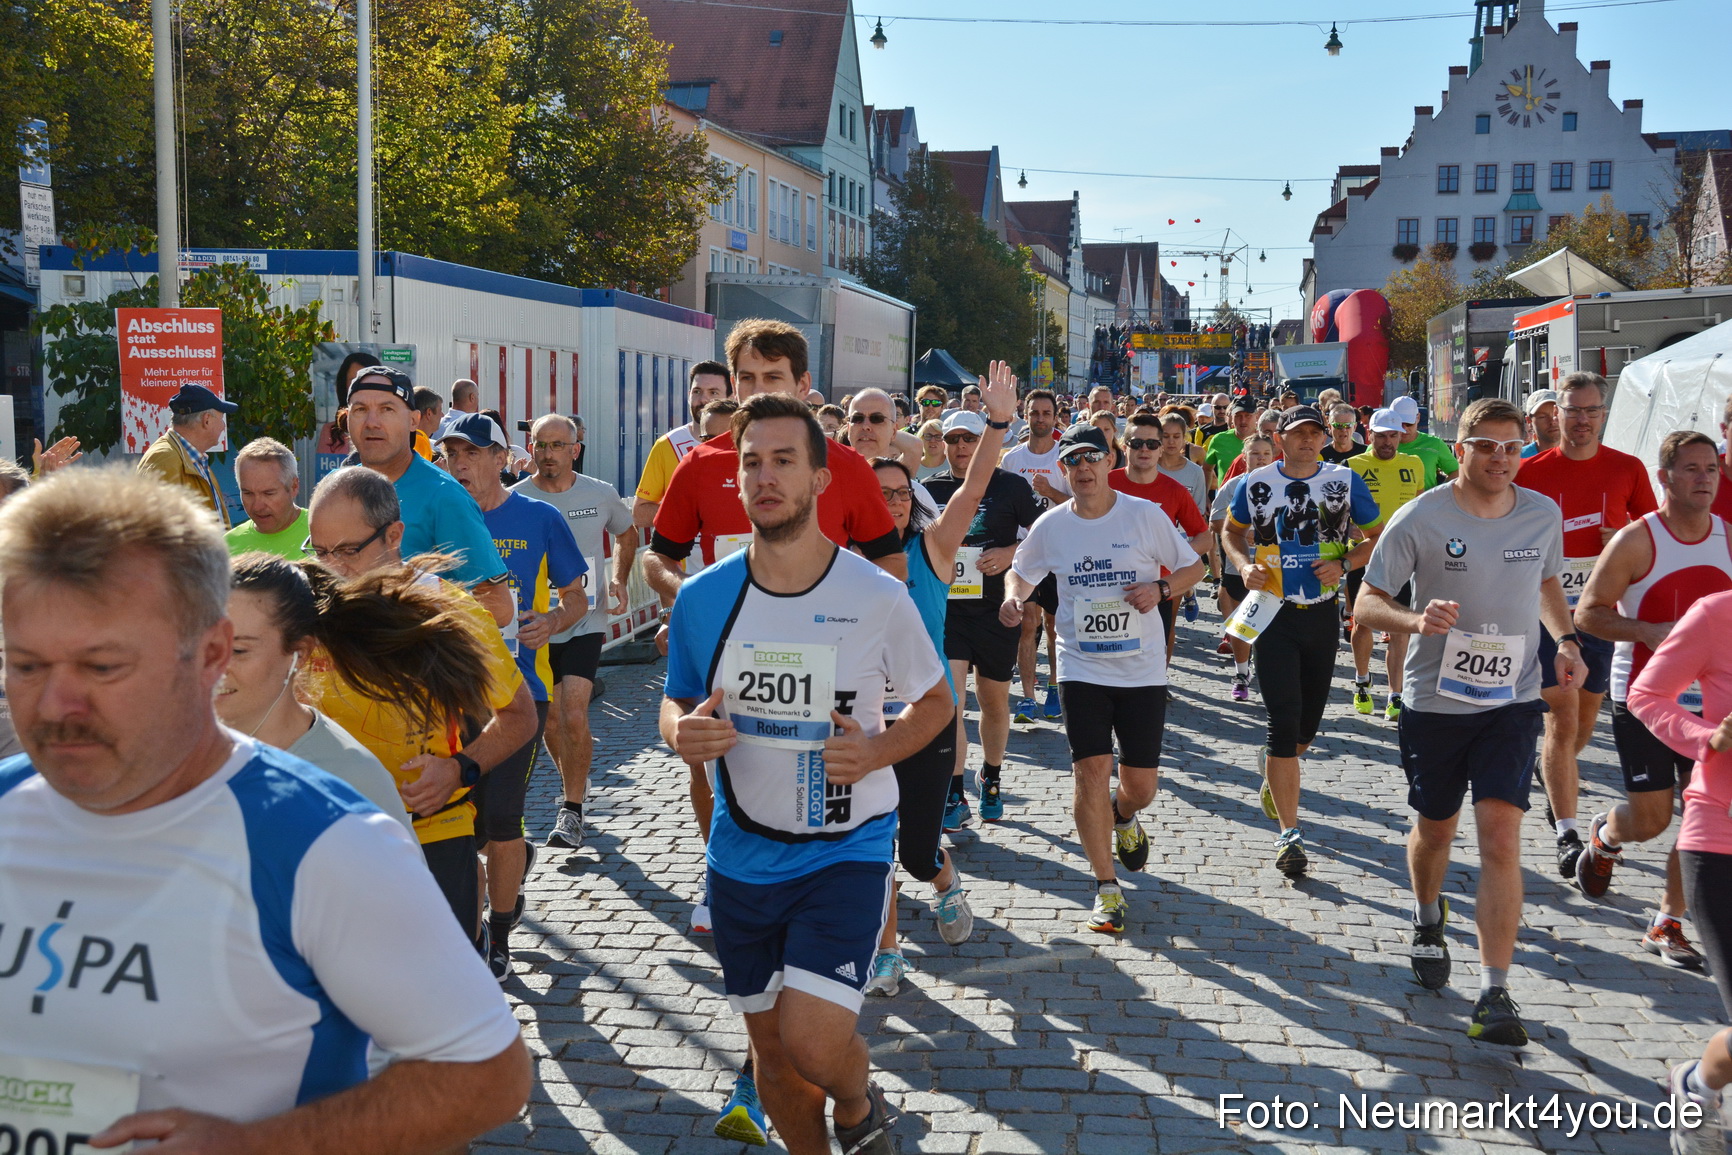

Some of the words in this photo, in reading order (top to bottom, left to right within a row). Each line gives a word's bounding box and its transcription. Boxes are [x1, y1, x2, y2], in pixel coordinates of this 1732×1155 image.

[24, 200, 52, 212] Parkschein
[27, 212, 51, 222] werktags
[127, 318, 215, 333] Abschluss
[127, 335, 157, 344] statt
[1163, 336, 1199, 346] START
[128, 345, 216, 358] Ausschluss!
[144, 368, 170, 376] Mehr
[171, 367, 200, 376] Lehrer
[201, 367, 214, 376] für
[140, 378, 178, 387] kleinere
[568, 507, 597, 518] BOCK
[1573, 518, 1591, 527] DEHN
[1504, 548, 1540, 559] BOCK
[1074, 556, 1113, 573] KÖNIG
[1282, 554, 1303, 569] 25.
[1444, 560, 1467, 568] PARTL
[1068, 570, 1137, 587] Engineering
[1091, 601, 1121, 610] BOCK
[1083, 612, 1131, 633] 2607
[1096, 643, 1123, 652] Martin
[1470, 640, 1507, 650] BOCK
[754, 651, 803, 664] BOCK
[1454, 651, 1512, 677] 2043
[1457, 674, 1474, 683] PARTL
[738, 671, 812, 705] 2501
[1464, 685, 1492, 698] Oliver
[747, 706, 767, 715] PARTL
[768, 708, 801, 717] Neumarkt
[756, 721, 799, 737] Robert
[797, 753, 805, 784] WATER
[796, 787, 805, 822] Solutions
[835, 967, 859, 982] adidas
